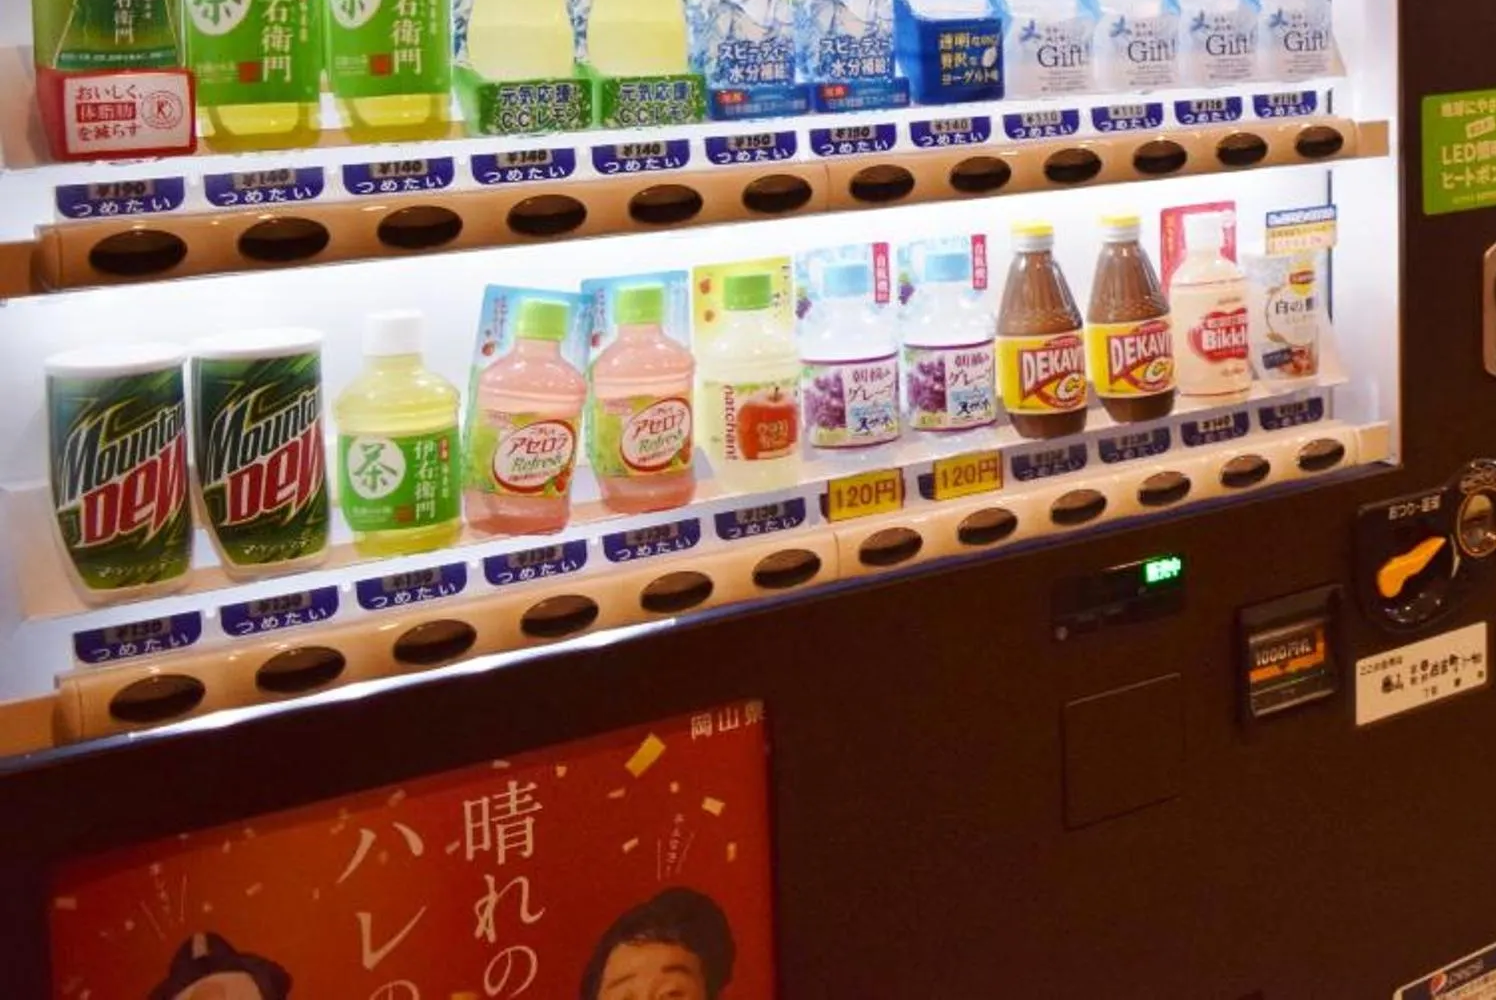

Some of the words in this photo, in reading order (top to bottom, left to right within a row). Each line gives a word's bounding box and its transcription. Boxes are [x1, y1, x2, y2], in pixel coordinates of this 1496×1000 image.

[1182, 110, 1236, 124] つめたい
[1263, 104, 1313, 117] つめたい
[1012, 124, 1073, 138] つめたい
[1100, 117, 1158, 131] つめたい
[820, 140, 888, 155] つめたい
[919, 132, 984, 147] つめたい
[604, 157, 681, 172] つめたい
[716, 148, 788, 163] つめたい
[356, 177, 444, 194] つめたい
[485, 167, 565, 183] つめたい
[218, 187, 313, 205] つめたい
[73, 197, 172, 217] つめたい
[632, 409, 686, 439] アセロラ
[508, 433, 569, 456] アセロラ
[352, 443, 398, 492] 茶
[941, 457, 999, 488] 120円
[414, 439, 437, 518] 伊右衛門
[835, 479, 897, 509] 120円
[728, 517, 799, 538] つめたい
[617, 537, 692, 560] つめたい
[498, 561, 576, 583] つめたい
[371, 583, 455, 608] つめたい
[236, 608, 326, 633] つめたい
[93, 634, 188, 659] つめたい
[463, 780, 546, 998] 晴れの
